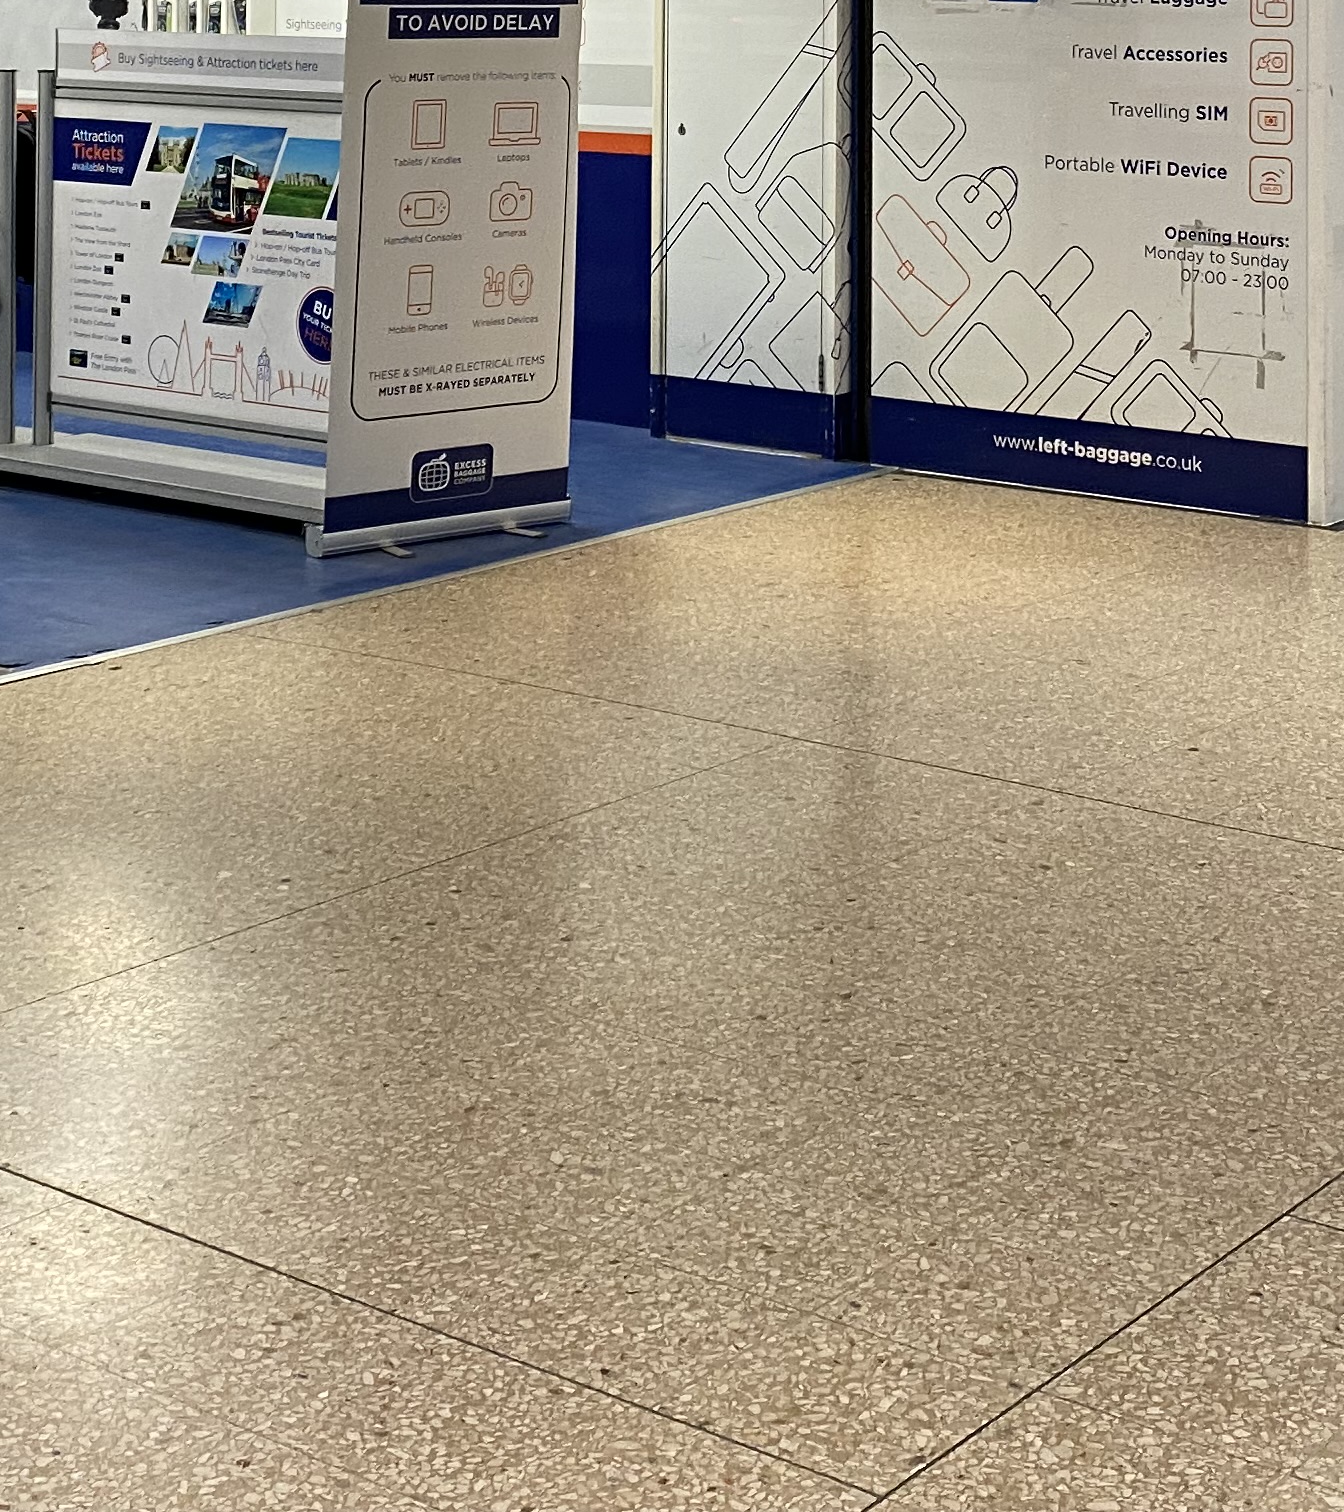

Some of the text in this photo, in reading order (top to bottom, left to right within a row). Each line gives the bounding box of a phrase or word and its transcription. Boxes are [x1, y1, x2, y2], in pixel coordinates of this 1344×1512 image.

[286, 18, 342, 32] Sightseeing
[396, 14, 554, 31] TO AVOID DELAY
[118, 52, 318, 72] Buy Sightseeing & Attraction tickets here
[1123, 46, 1228, 64] Accessories
[389, 73, 406, 83] You
[408, 72, 434, 82] MUST
[1109, 102, 1228, 122] Travelling SIM
[72, 128, 124, 144] Attraction
[72, 143, 124, 162] Tickets
[497, 154, 530, 163] Laptops
[72, 162, 124, 174] available here
[394, 158, 424, 167] Tablets
[1044, 155, 1228, 180] Portable WiFi Device
[295, 230, 314, 240] Tourist
[384, 232, 462, 245] Handheld Consoles
[492, 229, 526, 238] Cameras
[1164, 226, 1290, 248] Opening Hours:
[256, 255, 278, 264] London
[306, 258, 320, 268] Card
[1144, 246, 1290, 271] Monday to Sunday
[287, 270, 298, 279] Day
[1181, 269, 1226, 286] 07:00
[313, 300, 332, 320] BU
[302, 312, 319, 327] YOUR
[472, 316, 538, 328] Wireless Devices
[388, 322, 448, 336] Mobile Phones
[368, 355, 545, 380] THESE & SIMILAR ELECTRICAL ITEMS
[378, 373, 536, 397] MUST BE X-RAYED SEPARATELY
[992, 434, 1202, 473] www.left-baggage.co.uk
[454, 458, 487, 470] EXCESS
[454, 468, 486, 478] BAGGAGE
